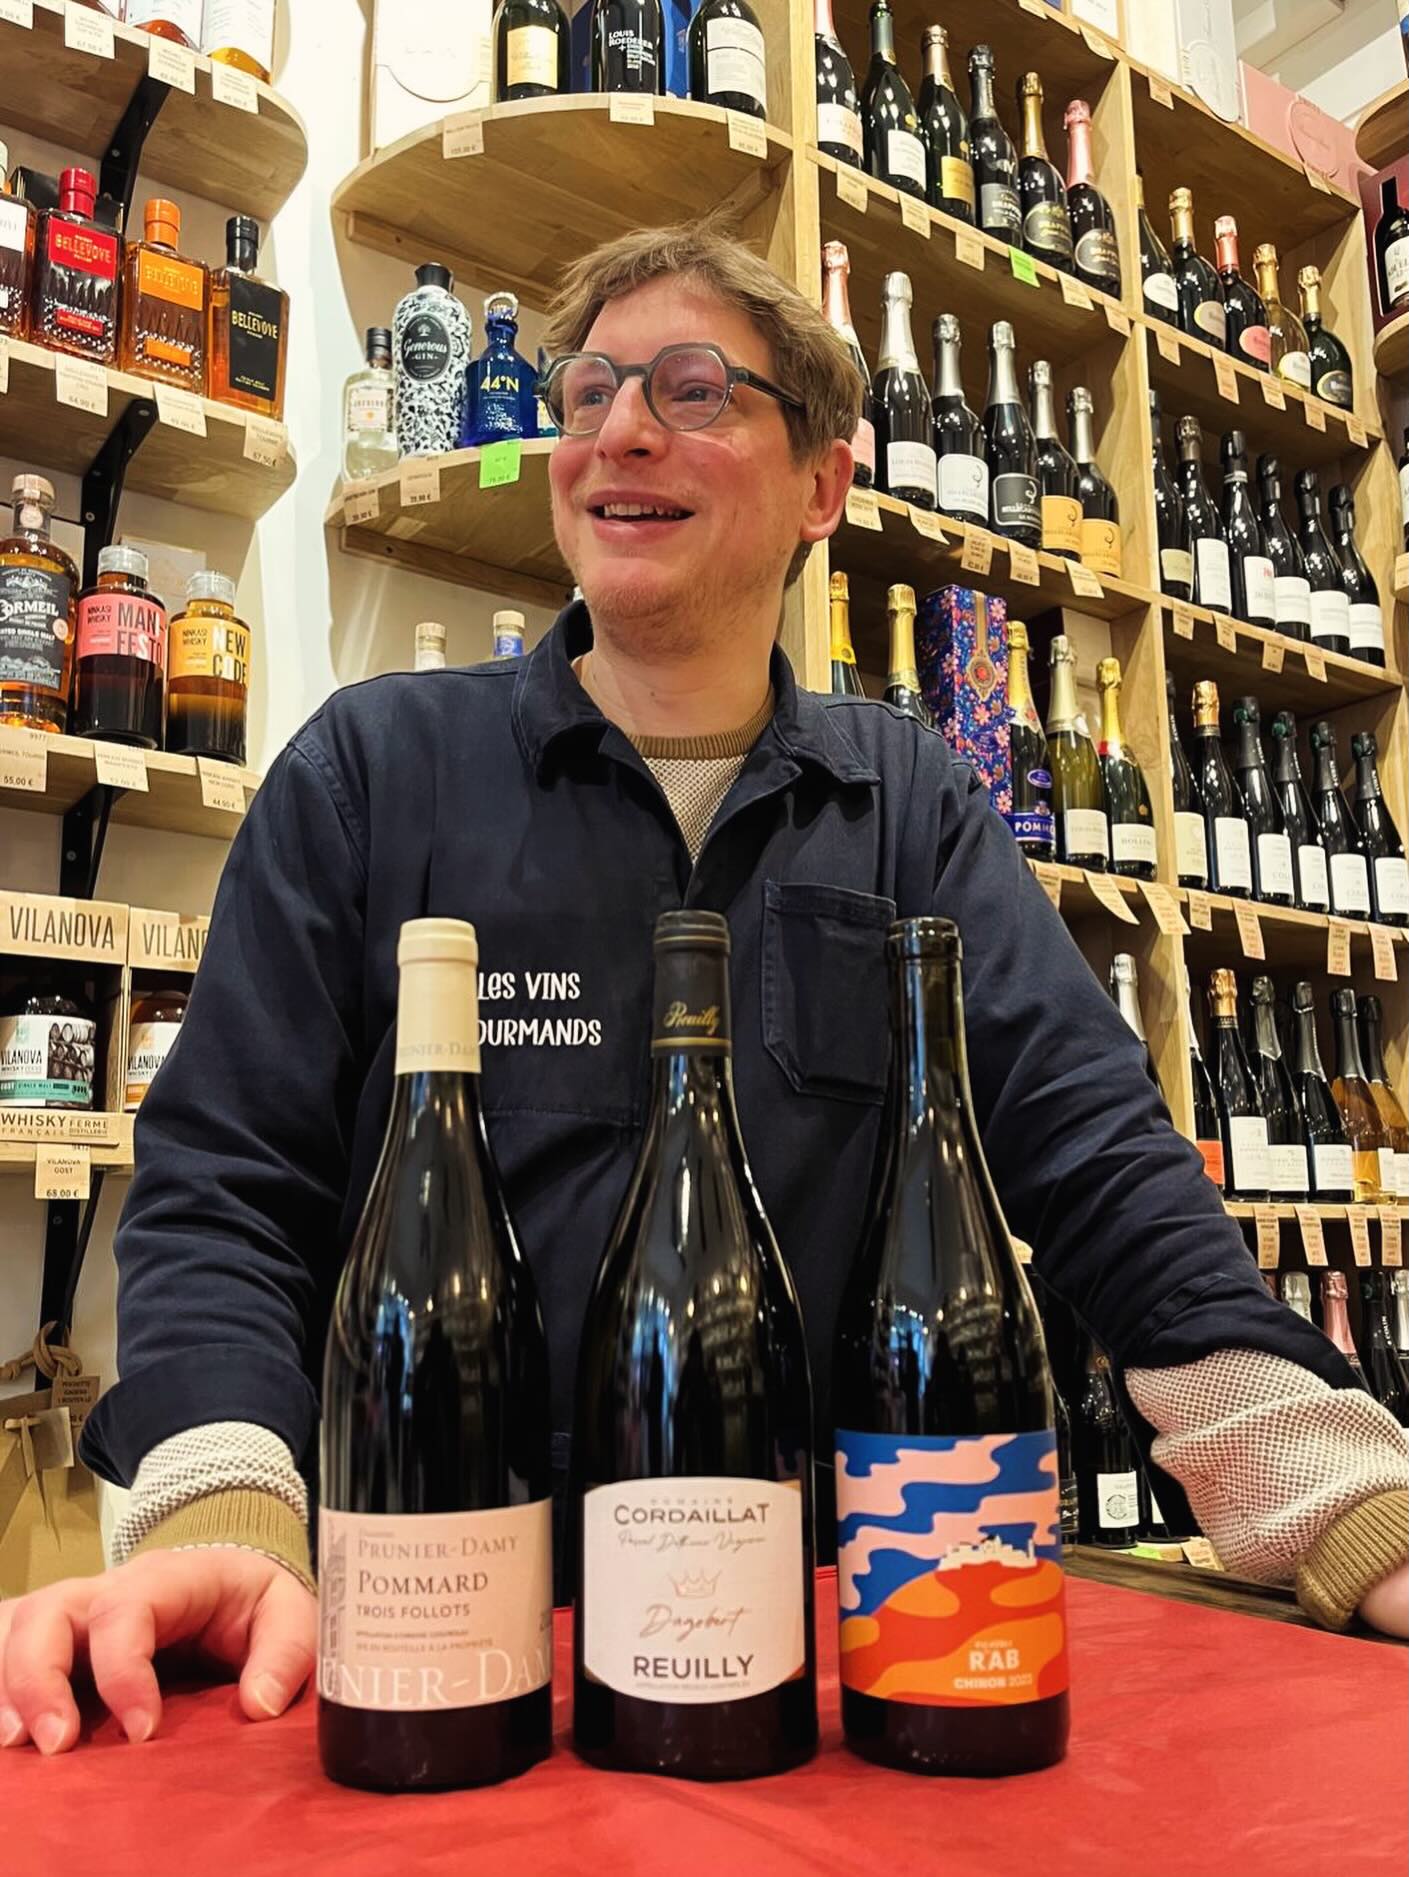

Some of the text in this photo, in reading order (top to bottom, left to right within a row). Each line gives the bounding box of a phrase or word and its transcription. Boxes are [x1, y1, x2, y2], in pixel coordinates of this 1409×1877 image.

[609, 30, 634, 39] LOUIS
[232, 310, 278, 339] BELLEVOYE
[403, 338, 448, 359] Generous
[414, 352, 433, 360] GIN
[212, 625, 247, 658] NEW
[10, 905, 115, 950] VILANOVA
[525, 971, 580, 1001] VINS
[664, 1001, 720, 1035] Reuilly
[1, 1112, 66, 1128] WHISKY
[69, 1119, 107, 1129] FERME
[1, 1127, 65, 1137] FRANÇAIS
[614, 1503, 770, 1525] CORDAILLAT
[358, 1535, 519, 1559] PRUNIER-DAMY
[358, 1567, 489, 1595] POMMARD
[356, 1603, 471, 1619] TROIS FOLLOTS
[638, 1603, 752, 1643] Dagobert
[633, 1655, 754, 1679] REUILLY
[970, 1648, 1020, 1671] RAB
